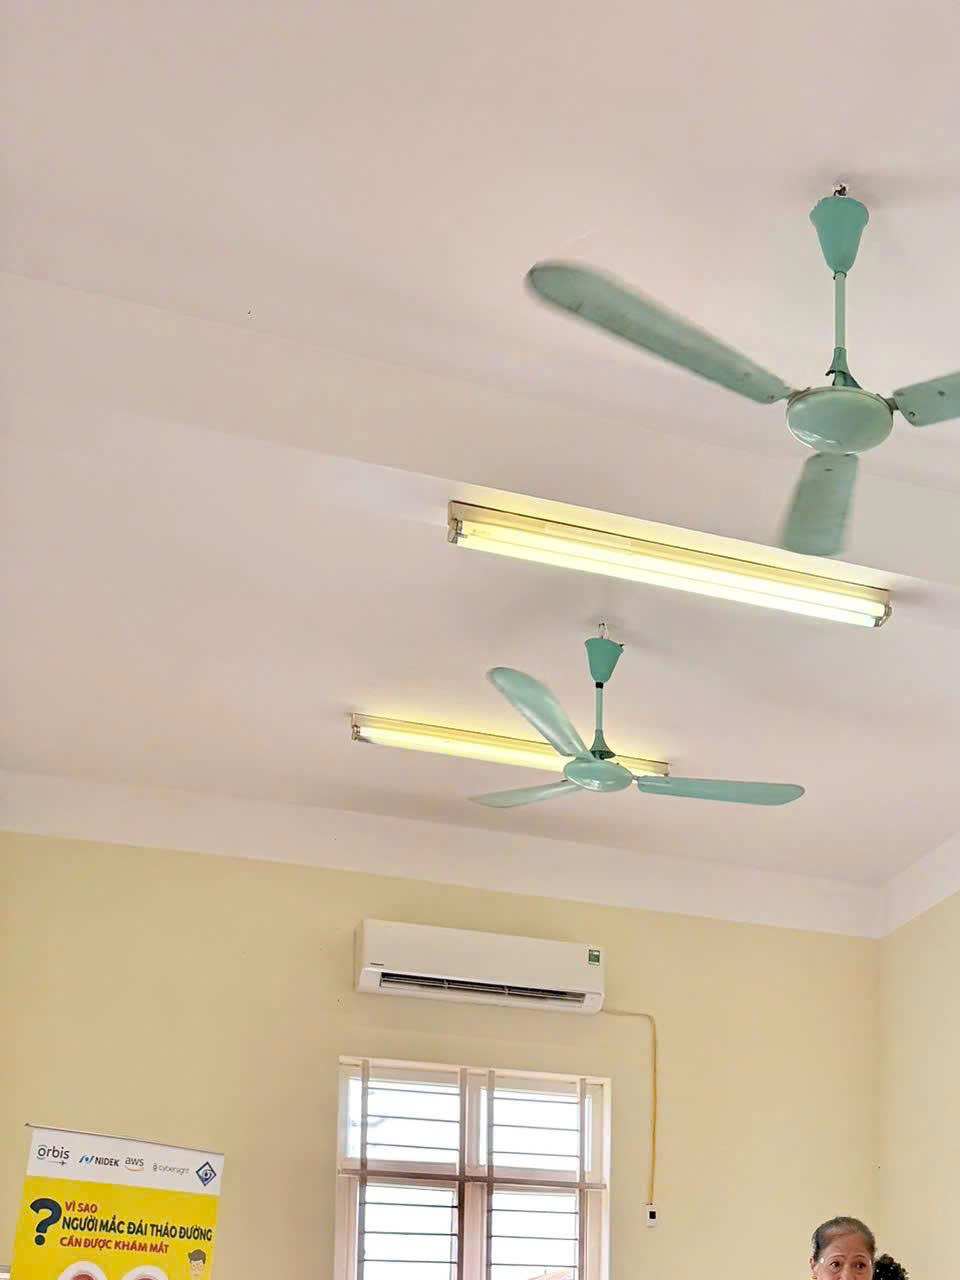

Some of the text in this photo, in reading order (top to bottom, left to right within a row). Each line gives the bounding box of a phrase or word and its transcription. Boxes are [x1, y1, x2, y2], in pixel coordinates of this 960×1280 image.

[37, 1145, 70, 1160] orbis
[94, 1157, 120, 1167] NIDEK
[125, 1156, 144, 1167] aws
[77, 1203, 97, 1214] SAO
[62, 1215, 98, 1232] NGƯỜI
[83, 1237, 112, 1251] ĐƯỢC
[114, 1240, 147, 1253] KHÁM
